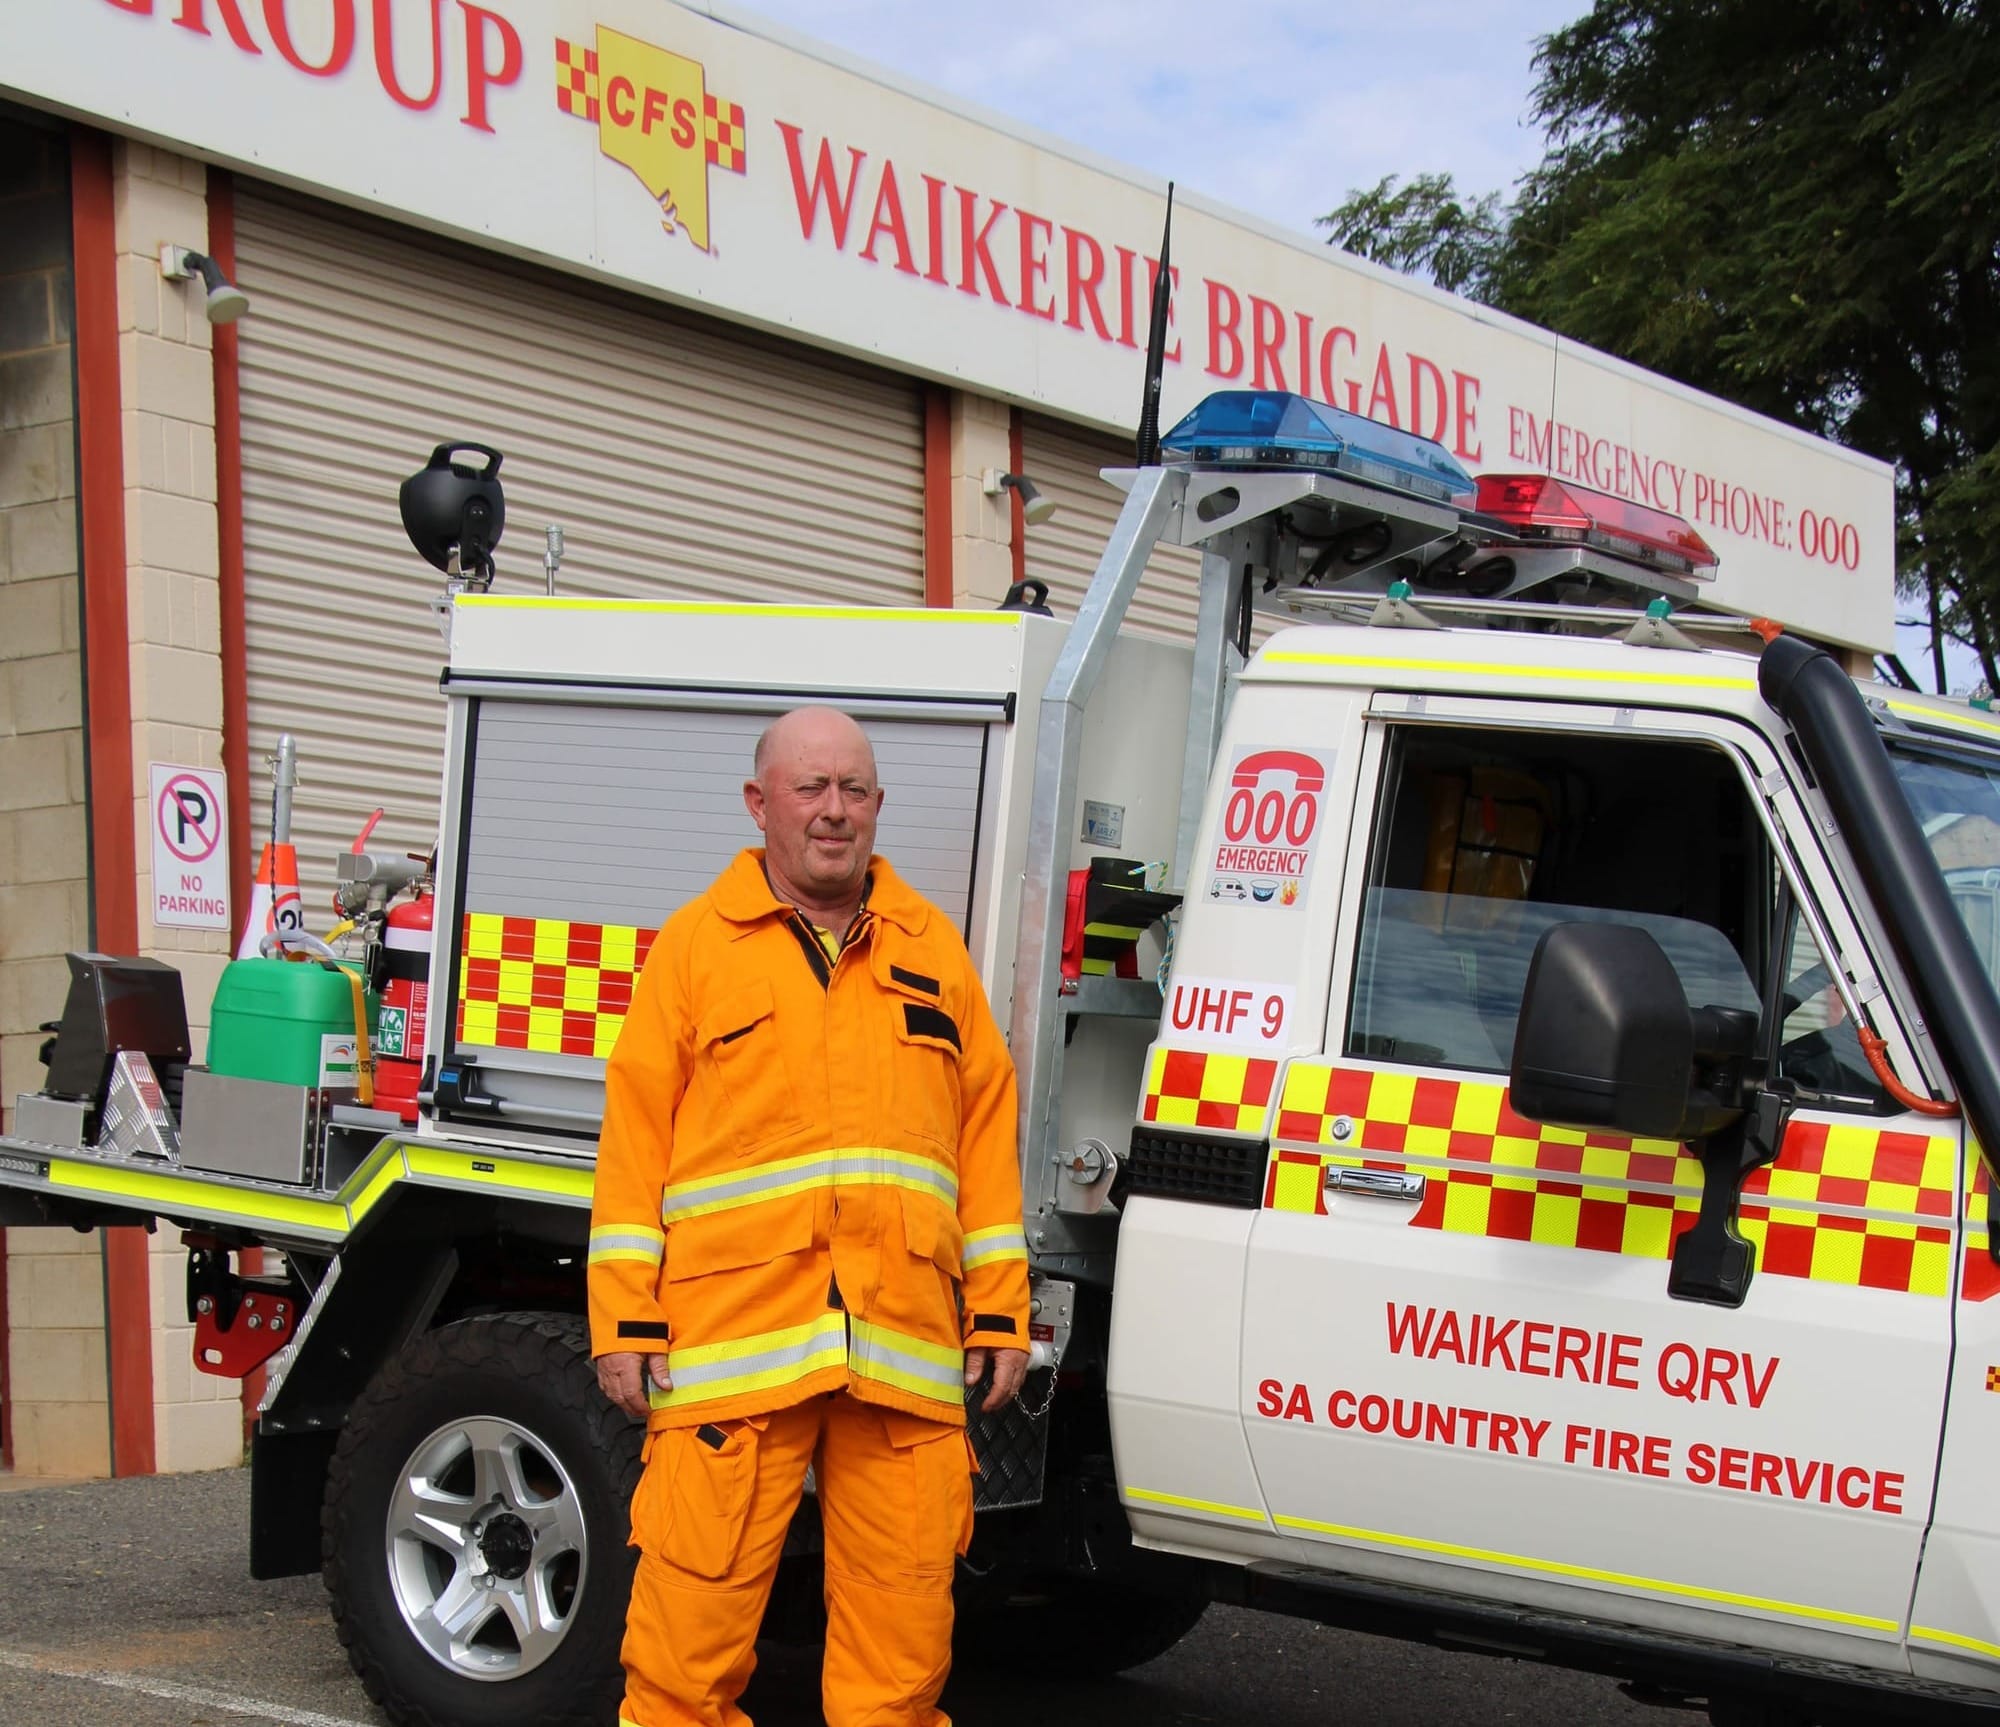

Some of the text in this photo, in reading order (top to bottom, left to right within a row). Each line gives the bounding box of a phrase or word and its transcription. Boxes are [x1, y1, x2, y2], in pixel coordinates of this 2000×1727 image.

[104, 0, 523, 134] OUP
[607, 76, 697, 149] CFS
[1203, 278, 1482, 463] BRIGADE
[1508, 406, 1860, 571] EMERGENCY PHONE: 000
[177, 791, 207, 844] P
[1224, 788, 1317, 847] 000
[180, 875, 203, 892] NO
[1215, 847, 1308, 875] EMERGENCY
[159, 894, 226, 916] PARKING
[1172, 985, 1284, 1039] UHF 9
[1386, 1302, 1780, 1409] WAIKERIE QRV
[1256, 1378, 1904, 1515] SA COUNTRY FIRE SERVICE
